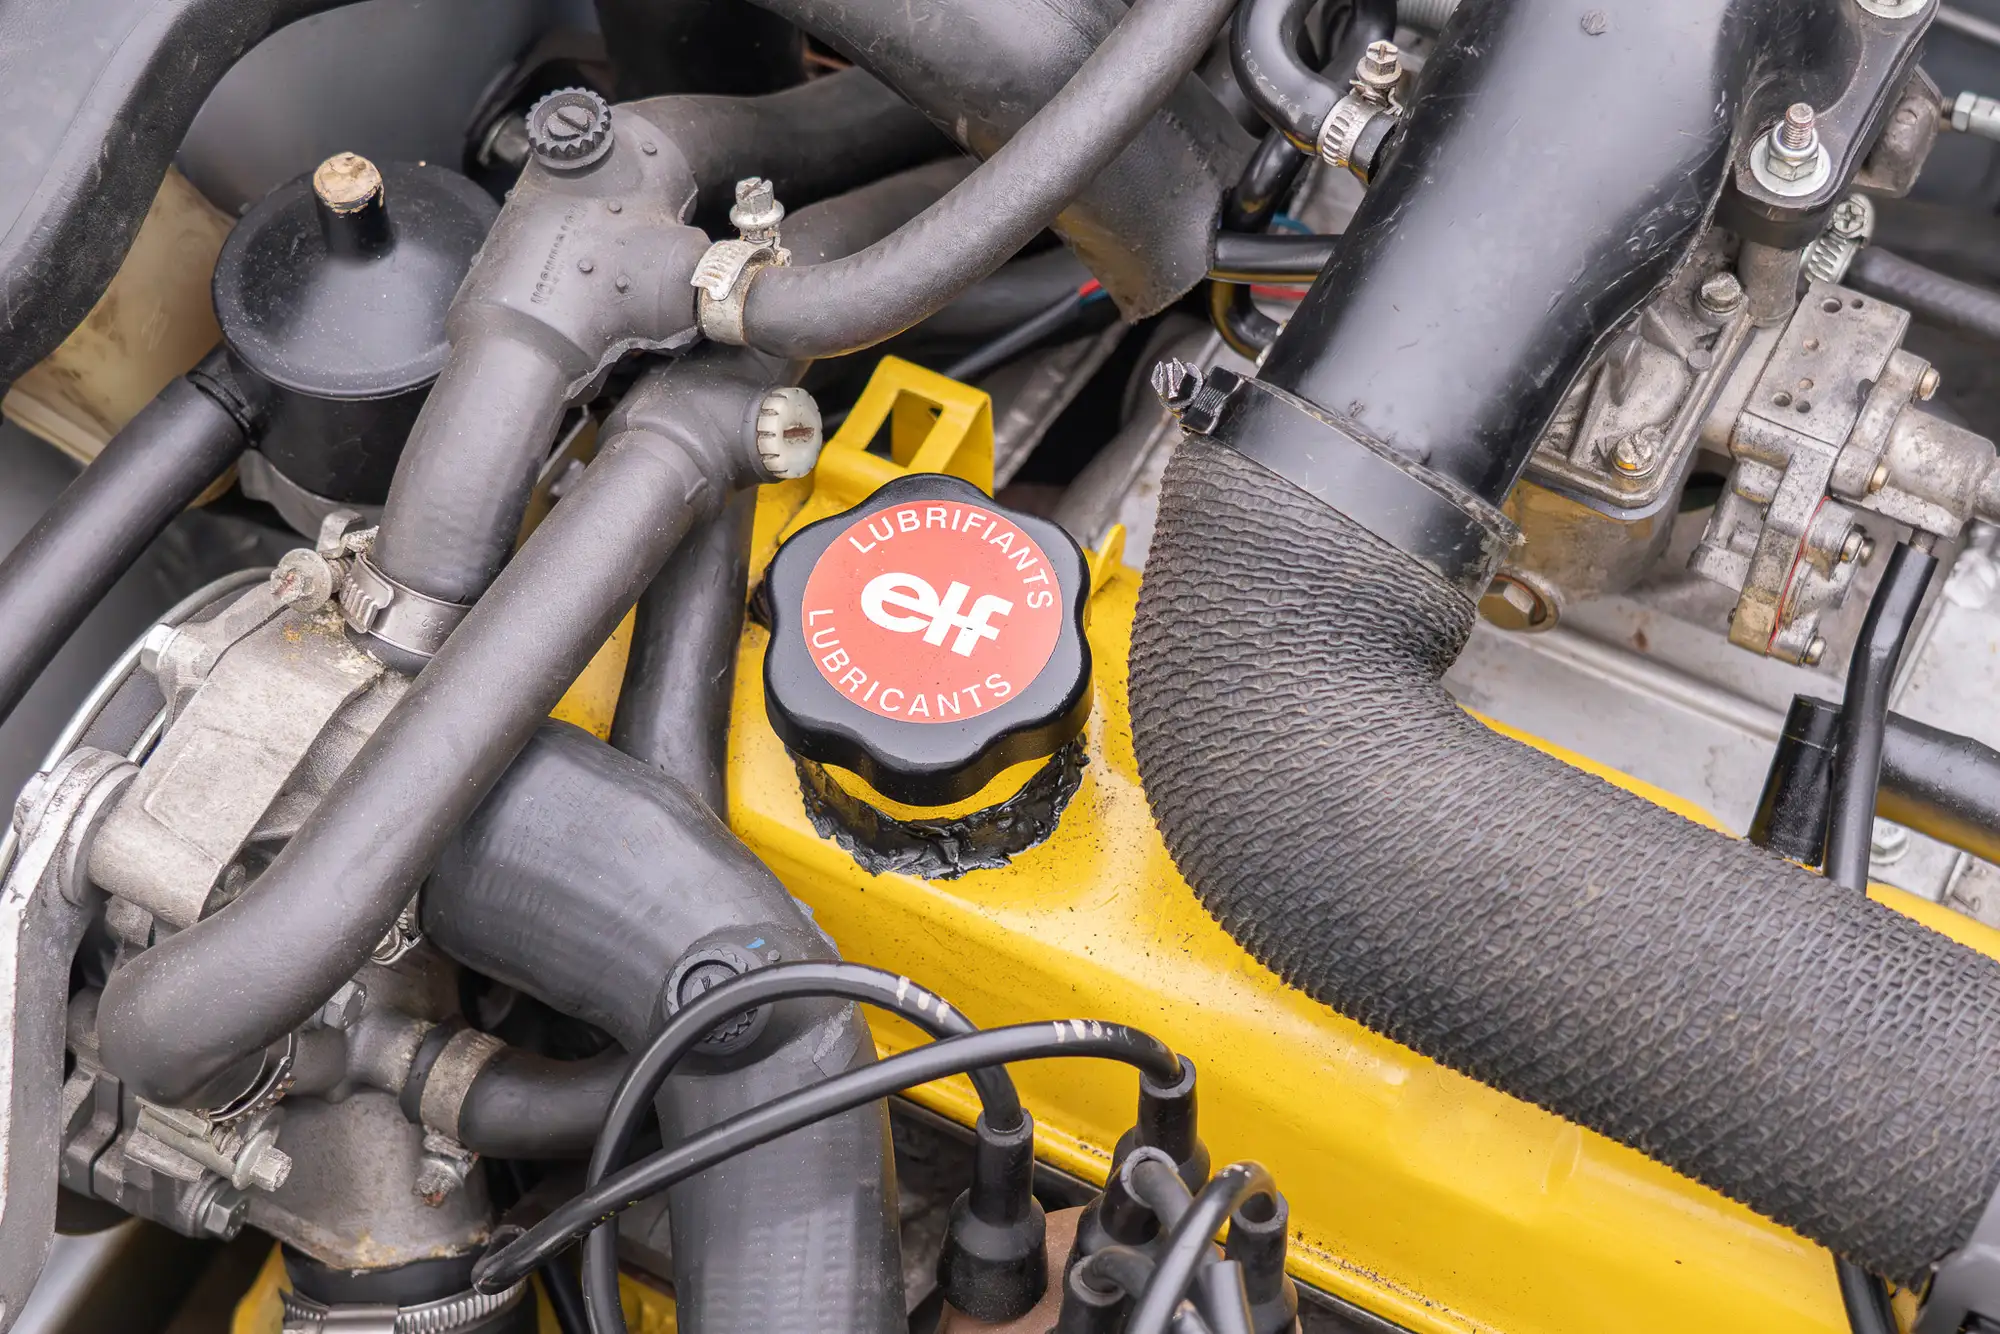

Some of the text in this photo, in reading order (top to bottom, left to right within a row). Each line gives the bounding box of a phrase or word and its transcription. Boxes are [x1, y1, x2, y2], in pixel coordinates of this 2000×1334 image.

[849, 507, 1053, 609] LUBRIFIANTS
[808, 608, 1012, 717] LUBRICANTS
[860, 572, 1014, 657] elf
